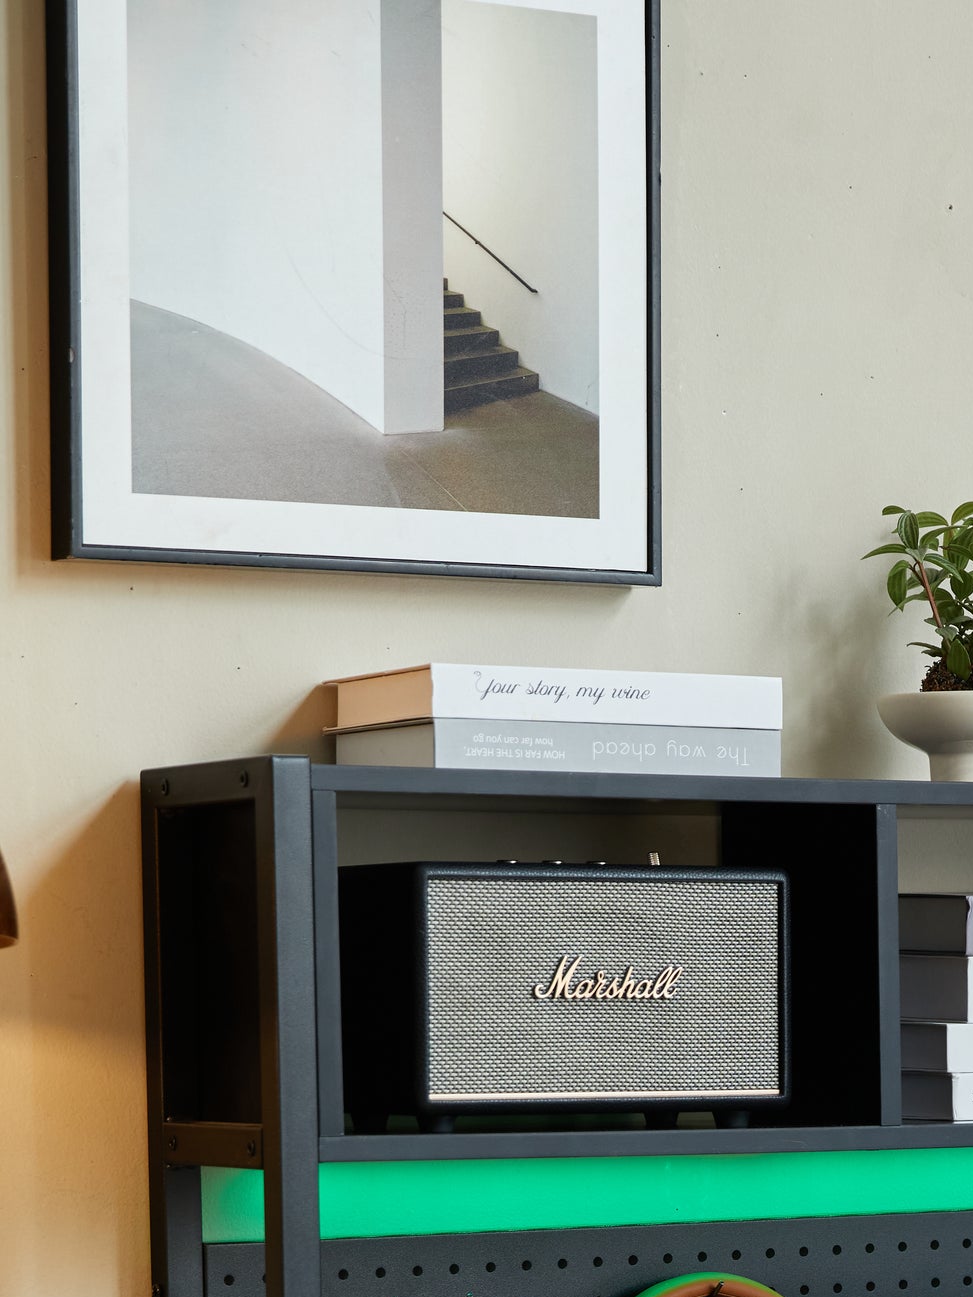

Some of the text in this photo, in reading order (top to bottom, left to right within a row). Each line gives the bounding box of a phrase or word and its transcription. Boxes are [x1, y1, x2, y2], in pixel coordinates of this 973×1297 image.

[473, 671, 650, 705] Your story, my wine
[473, 733, 484, 743] go
[486, 734, 502, 744] you
[504, 736, 519, 744] can
[535, 736, 553, 746] how
[496, 747, 513, 758] THE
[516, 748, 523, 758] IS
[526, 749, 540, 759] FAR
[544, 750, 566, 760] HOW
[592, 739, 750, 766] The way ahead
[534, 954, 683, 1000] Marshall
